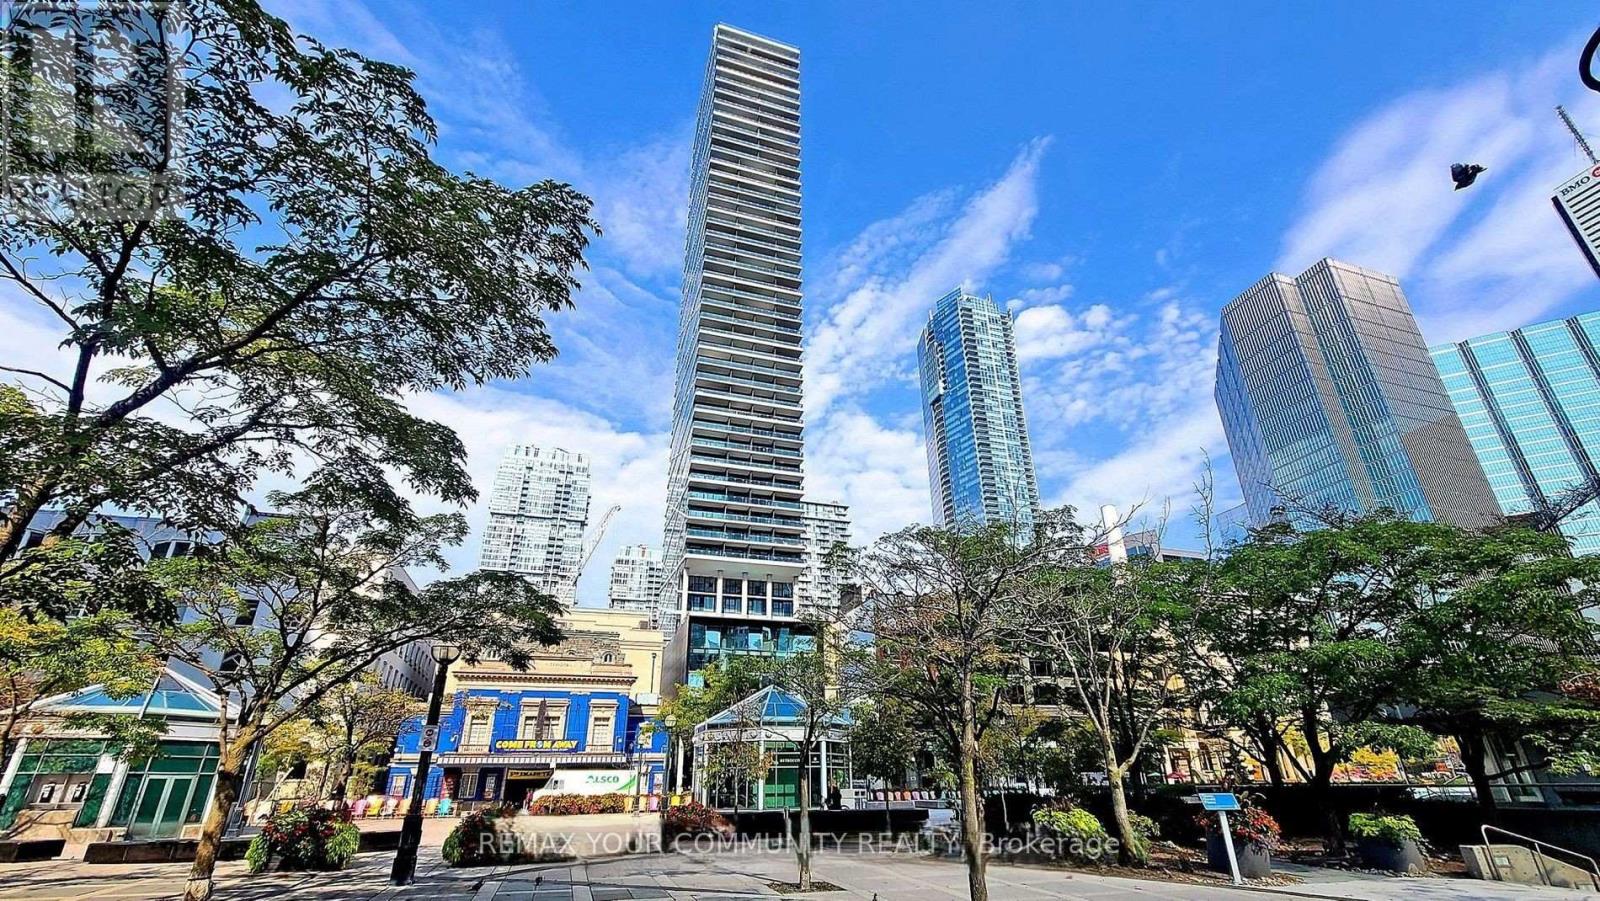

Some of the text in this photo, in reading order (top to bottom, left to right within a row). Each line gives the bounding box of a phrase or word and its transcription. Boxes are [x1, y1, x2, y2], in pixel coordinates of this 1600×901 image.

[1560, 176, 1591, 196] BMO
[495, 740, 579, 749] COME FROM AWAY
